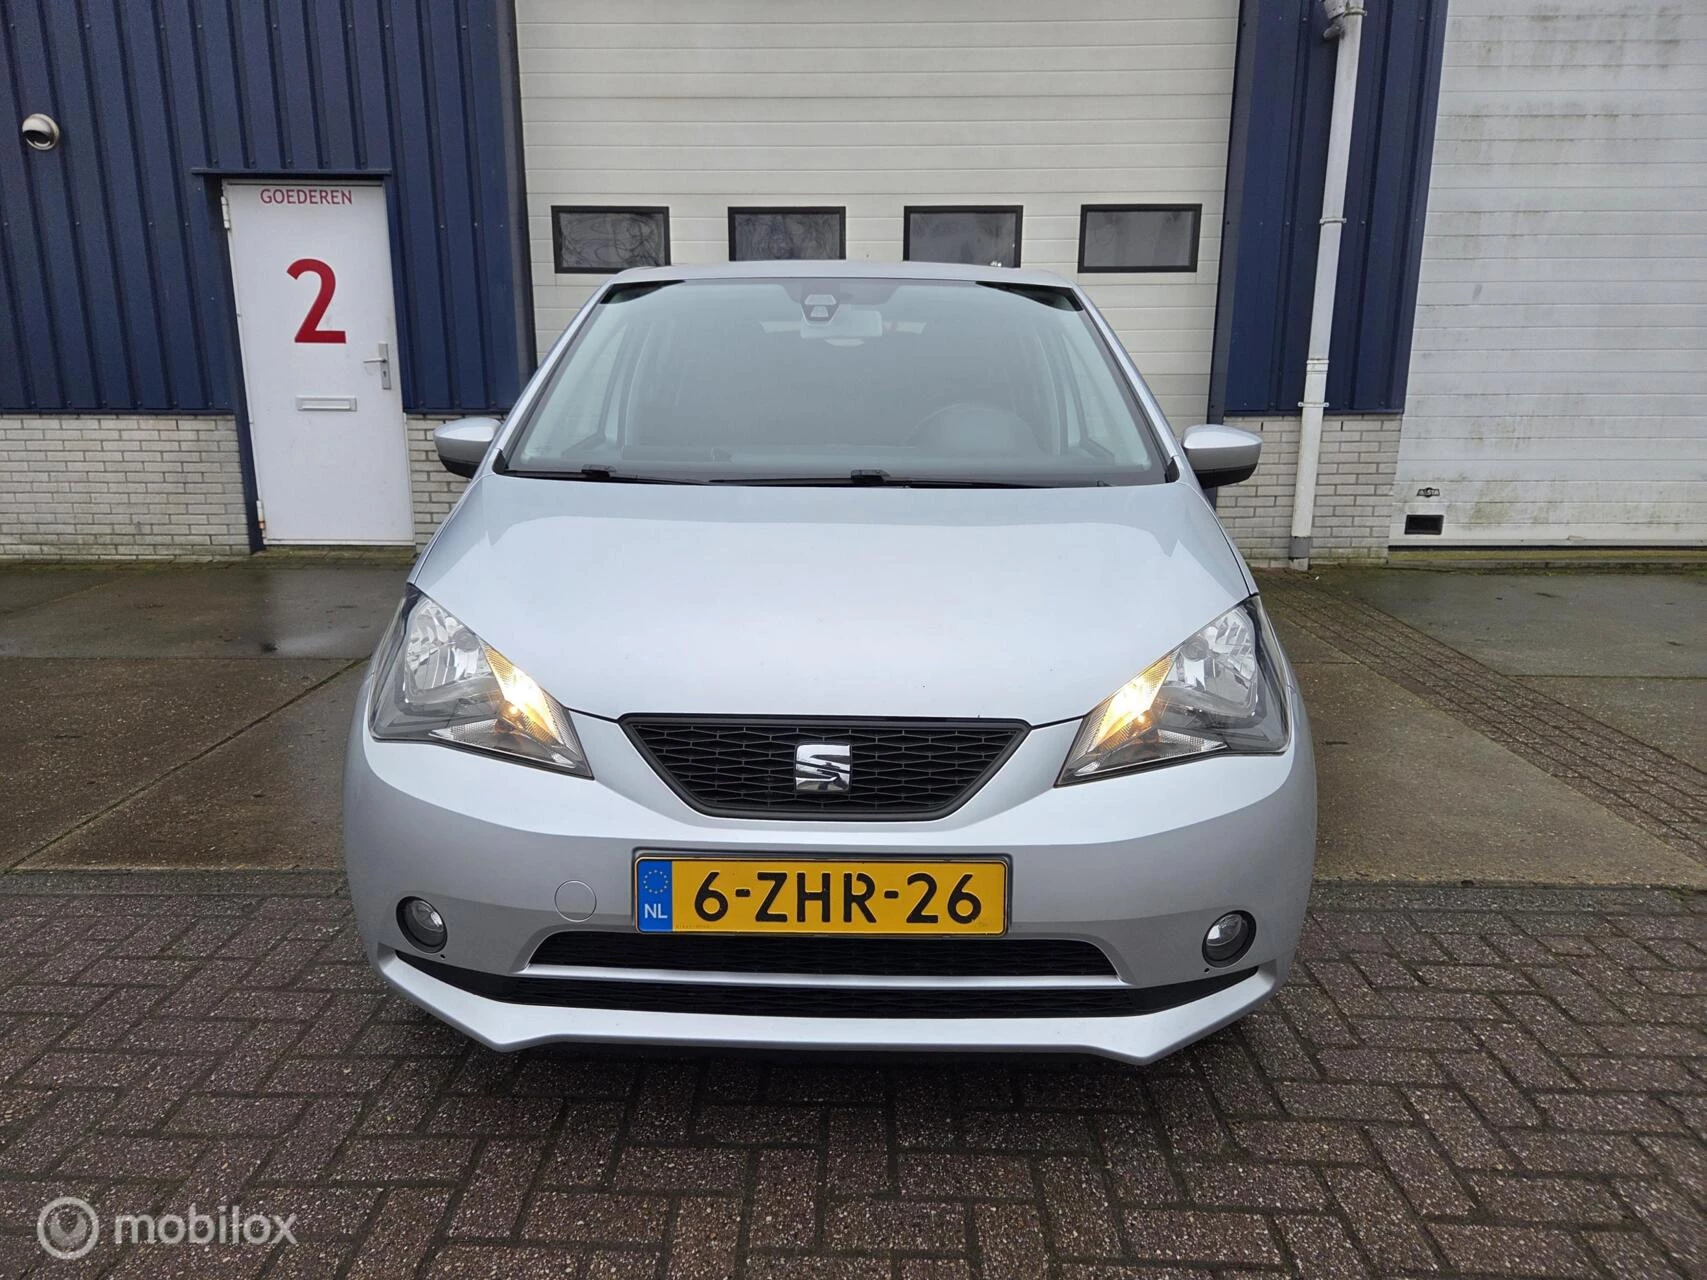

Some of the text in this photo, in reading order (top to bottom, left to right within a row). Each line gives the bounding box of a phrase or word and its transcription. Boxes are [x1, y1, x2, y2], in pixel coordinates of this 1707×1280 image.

[260, 188, 353, 205] GOEDEREN
[286, 258, 346, 344] 2
[644, 903, 668, 919] NL
[694, 871, 982, 924] 6-ZHR-26
